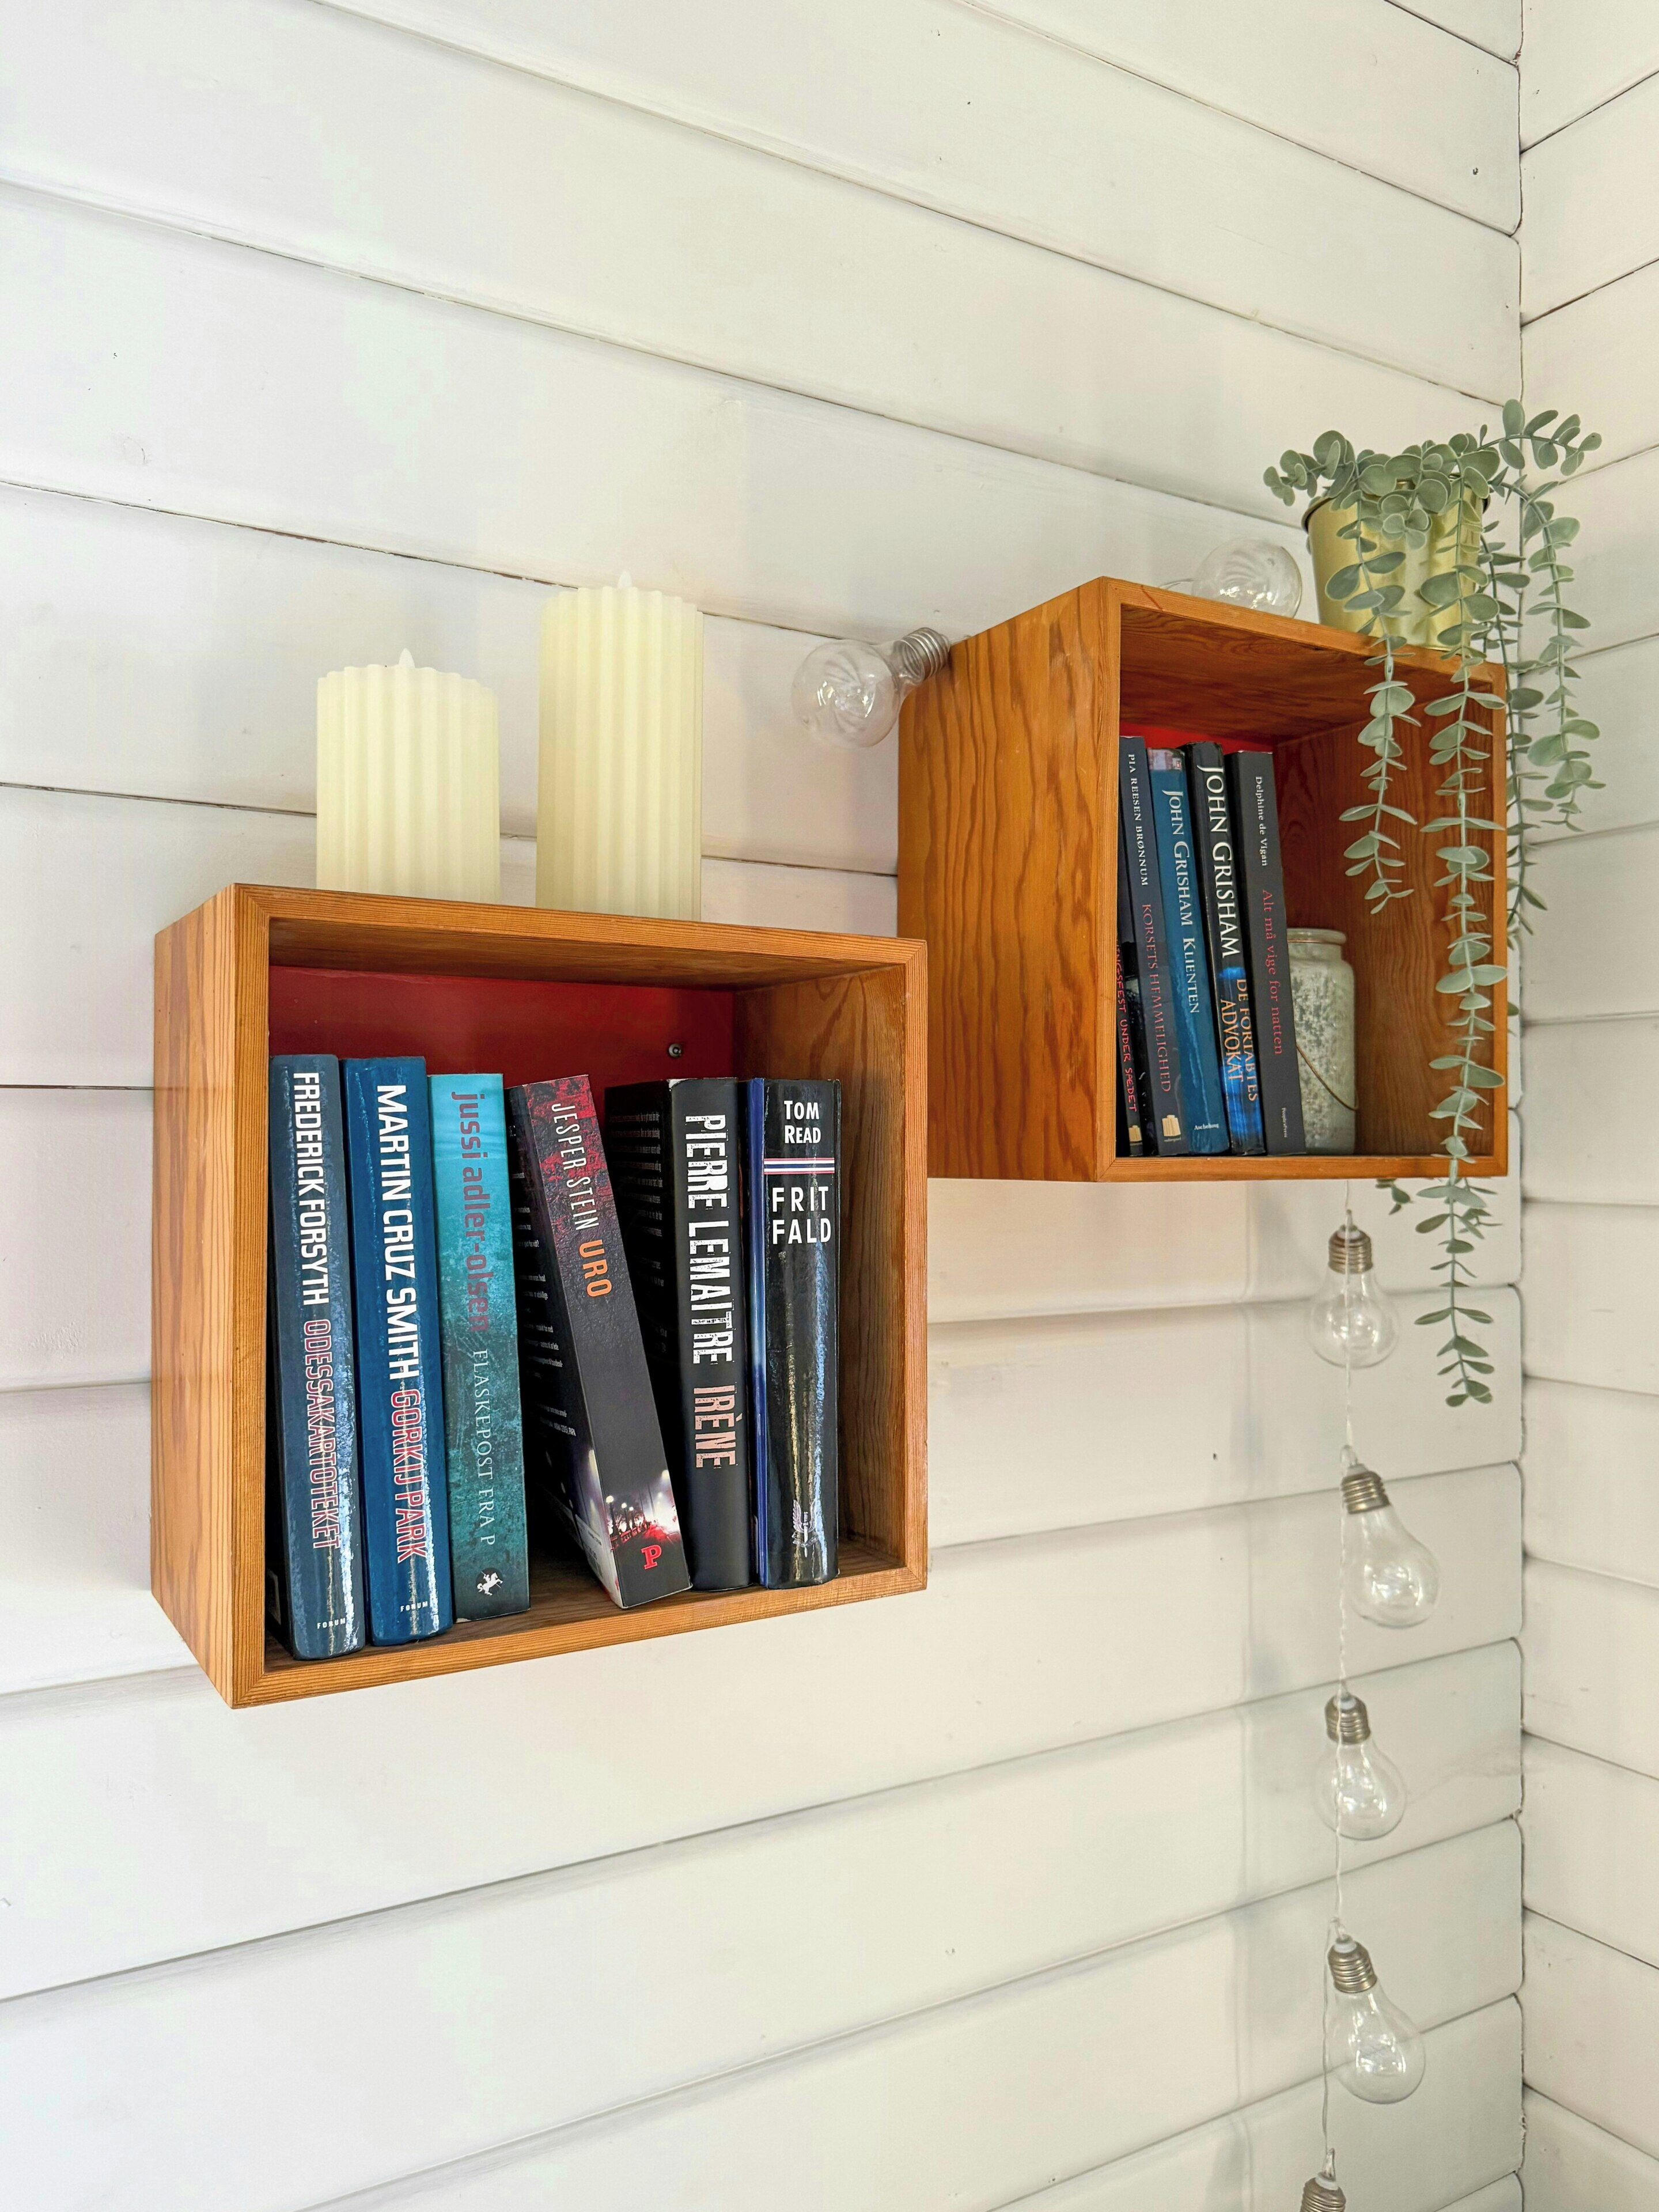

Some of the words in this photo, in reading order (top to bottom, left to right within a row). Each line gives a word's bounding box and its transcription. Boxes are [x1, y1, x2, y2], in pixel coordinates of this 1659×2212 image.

[1130, 778, 1141, 821] REESEN
[1255, 777, 1264, 820] Delphine
[1135, 825, 1148, 886] BRØNNUM
[1162, 790, 1184, 835] JOHN
[1174, 841, 1193, 926] GRISHAM
[1259, 823, 1266, 835] de
[1259, 838, 1268, 866] Vigan
[1196, 765, 1228, 834] JOHN
[1213, 842, 1241, 958] GRISHAM
[1263, 889, 1274, 912] Alt
[1265, 918, 1276, 939] må
[1142, 904, 1158, 969] KORSETS
[1265, 944, 1276, 975] vige
[1183, 938, 1199, 1013] KLIENTEN
[1237, 979, 1248, 1002] DE
[1270, 980, 1281, 1002] for
[1119, 1019, 1131, 1062] UNDER
[1221, 999, 1243, 1082] ADVOKAT
[1271, 1007, 1282, 1055] natten
[293, 1073, 324, 1196] FREDERICK
[452, 1091, 488, 1159] jussi
[551, 1103, 585, 1171] JESPER
[783, 1100, 820, 1120] TOM
[784, 1124, 821, 1144] READ
[377, 1085, 411, 1202] MARTIN
[685, 1114, 730, 1210] PIERRE
[566, 1176, 600, 1231] STEIN
[771, 1186, 829, 1213] FRIT
[298, 1199, 329, 1305] FORSYTH
[382, 1209, 415, 1281] CRUZ
[462, 1167, 491, 1332] adler-olsen
[771, 1218, 832, 1245] FALD
[579, 1239, 612, 1298] URO
[688, 1220, 736, 1365] LEMAITRE
[386, 1288, 419, 1380] SMITH
[304, 1319, 340, 1550] ODESSAKARTOTEKET
[391, 1388, 425, 1484] GORKIJ
[473, 1349, 494, 1480] FLASKEPOST
[694, 1384, 743, 1468] IRÈNE
[395, 1490, 427, 1565] PARK
[478, 1487, 495, 1528] FRA
[481, 1537, 495, 1546] P
[641, 1544, 662, 1570] P
[317, 1618, 346, 1629] FORUM
[400, 1601, 428, 1612] FORUM
